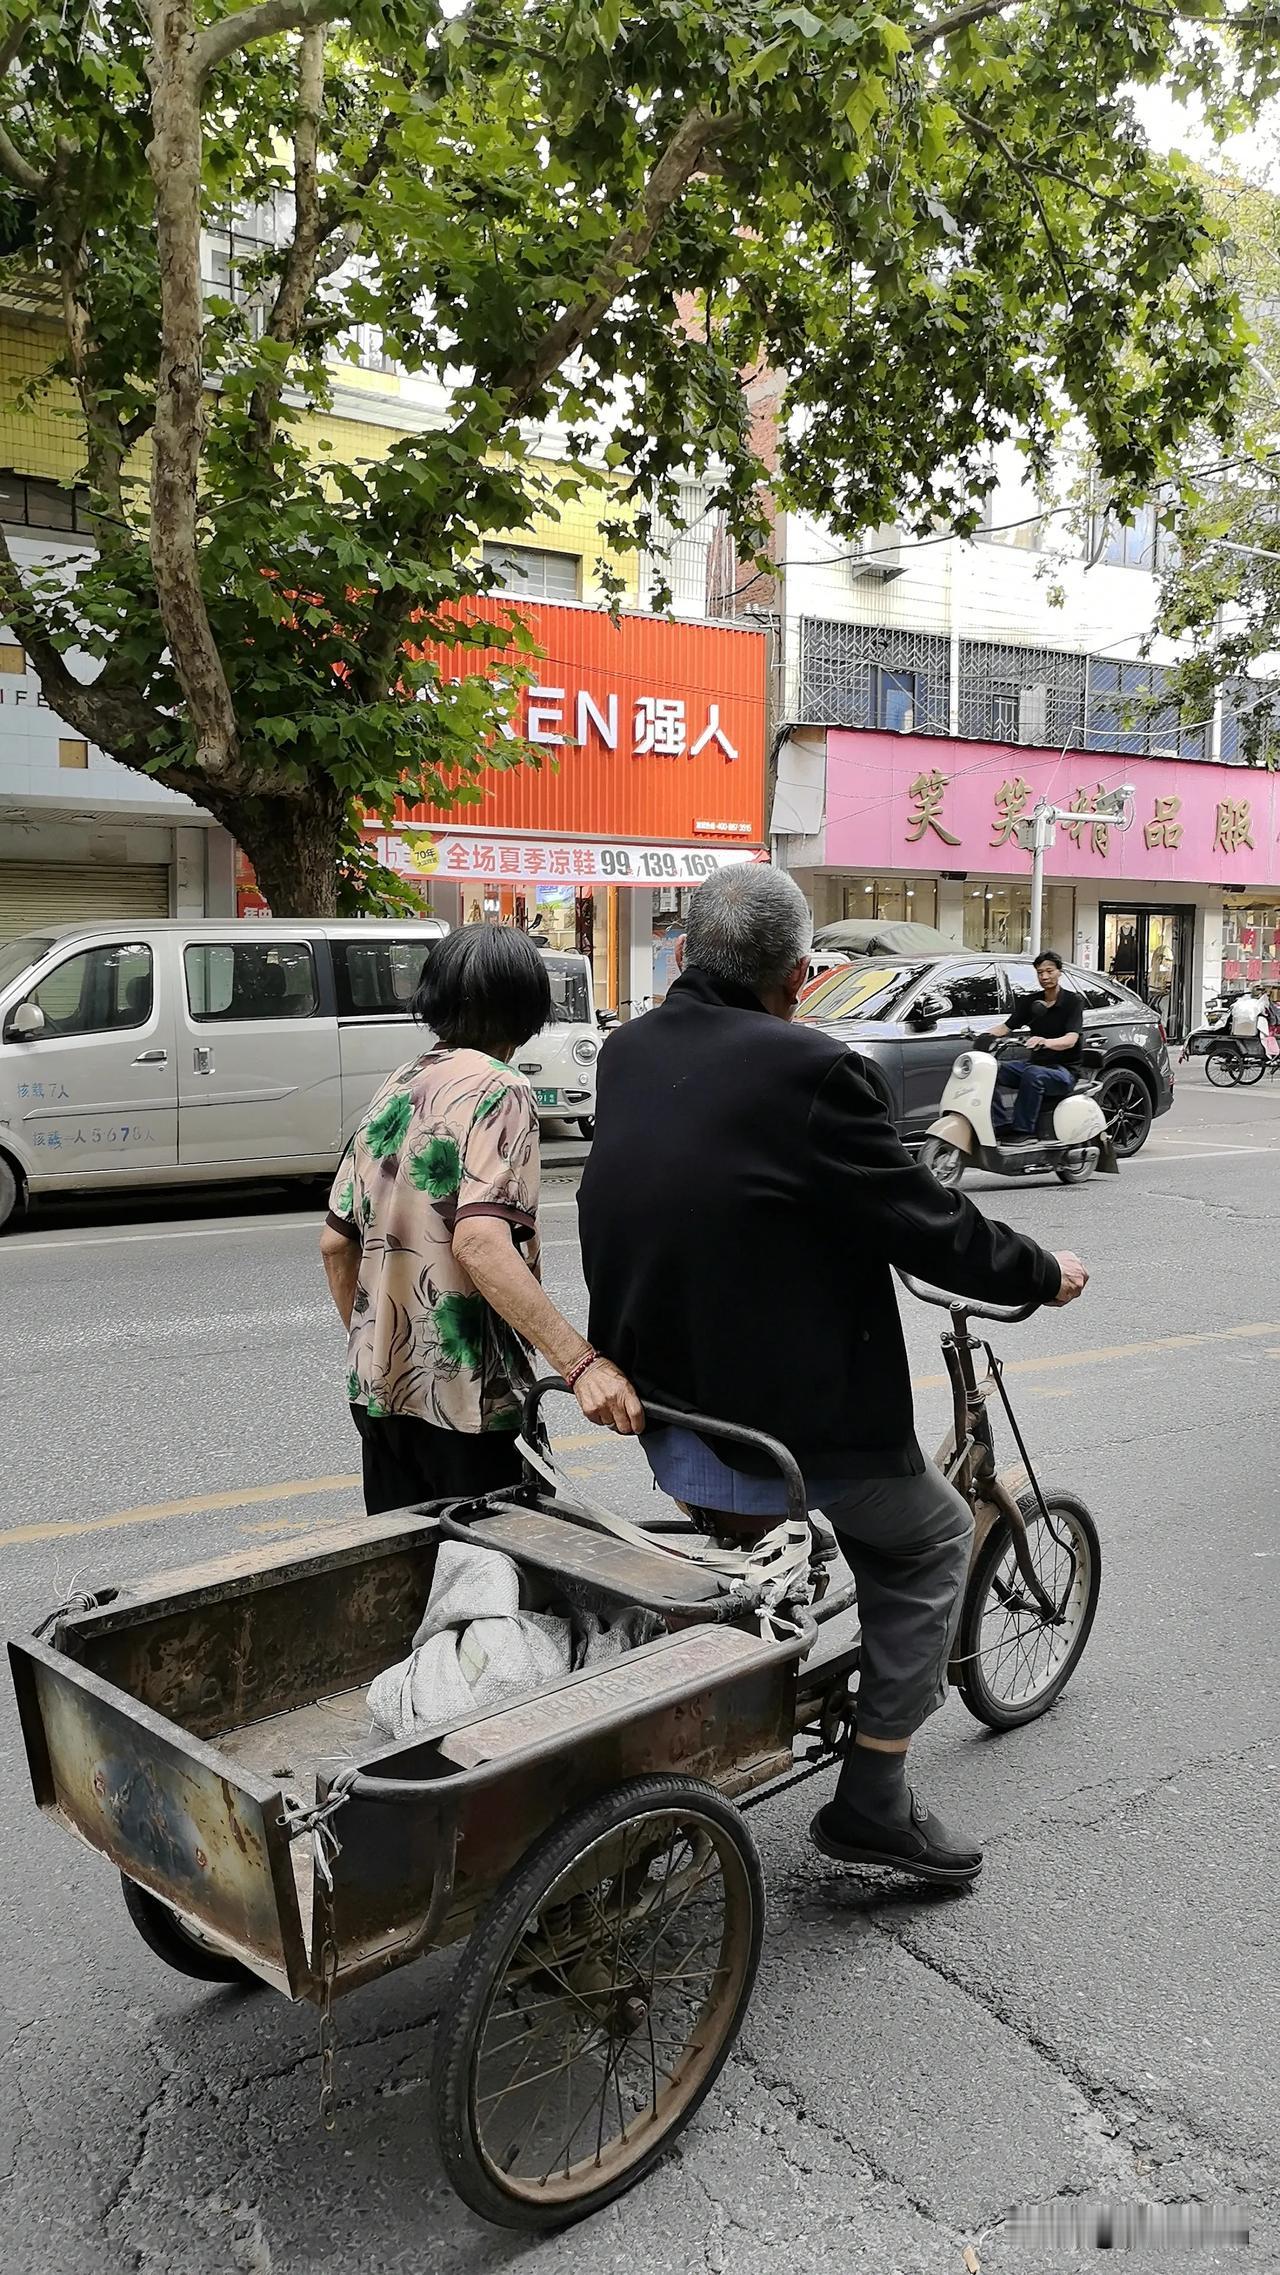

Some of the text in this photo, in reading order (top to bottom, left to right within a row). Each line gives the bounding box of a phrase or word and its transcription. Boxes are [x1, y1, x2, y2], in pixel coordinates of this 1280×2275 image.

[632, 696, 739, 760] 强人
[904, 768, 1280, 858] 笑笑精品服
[447, 842, 597, 877] 全场夏季凉鞋
